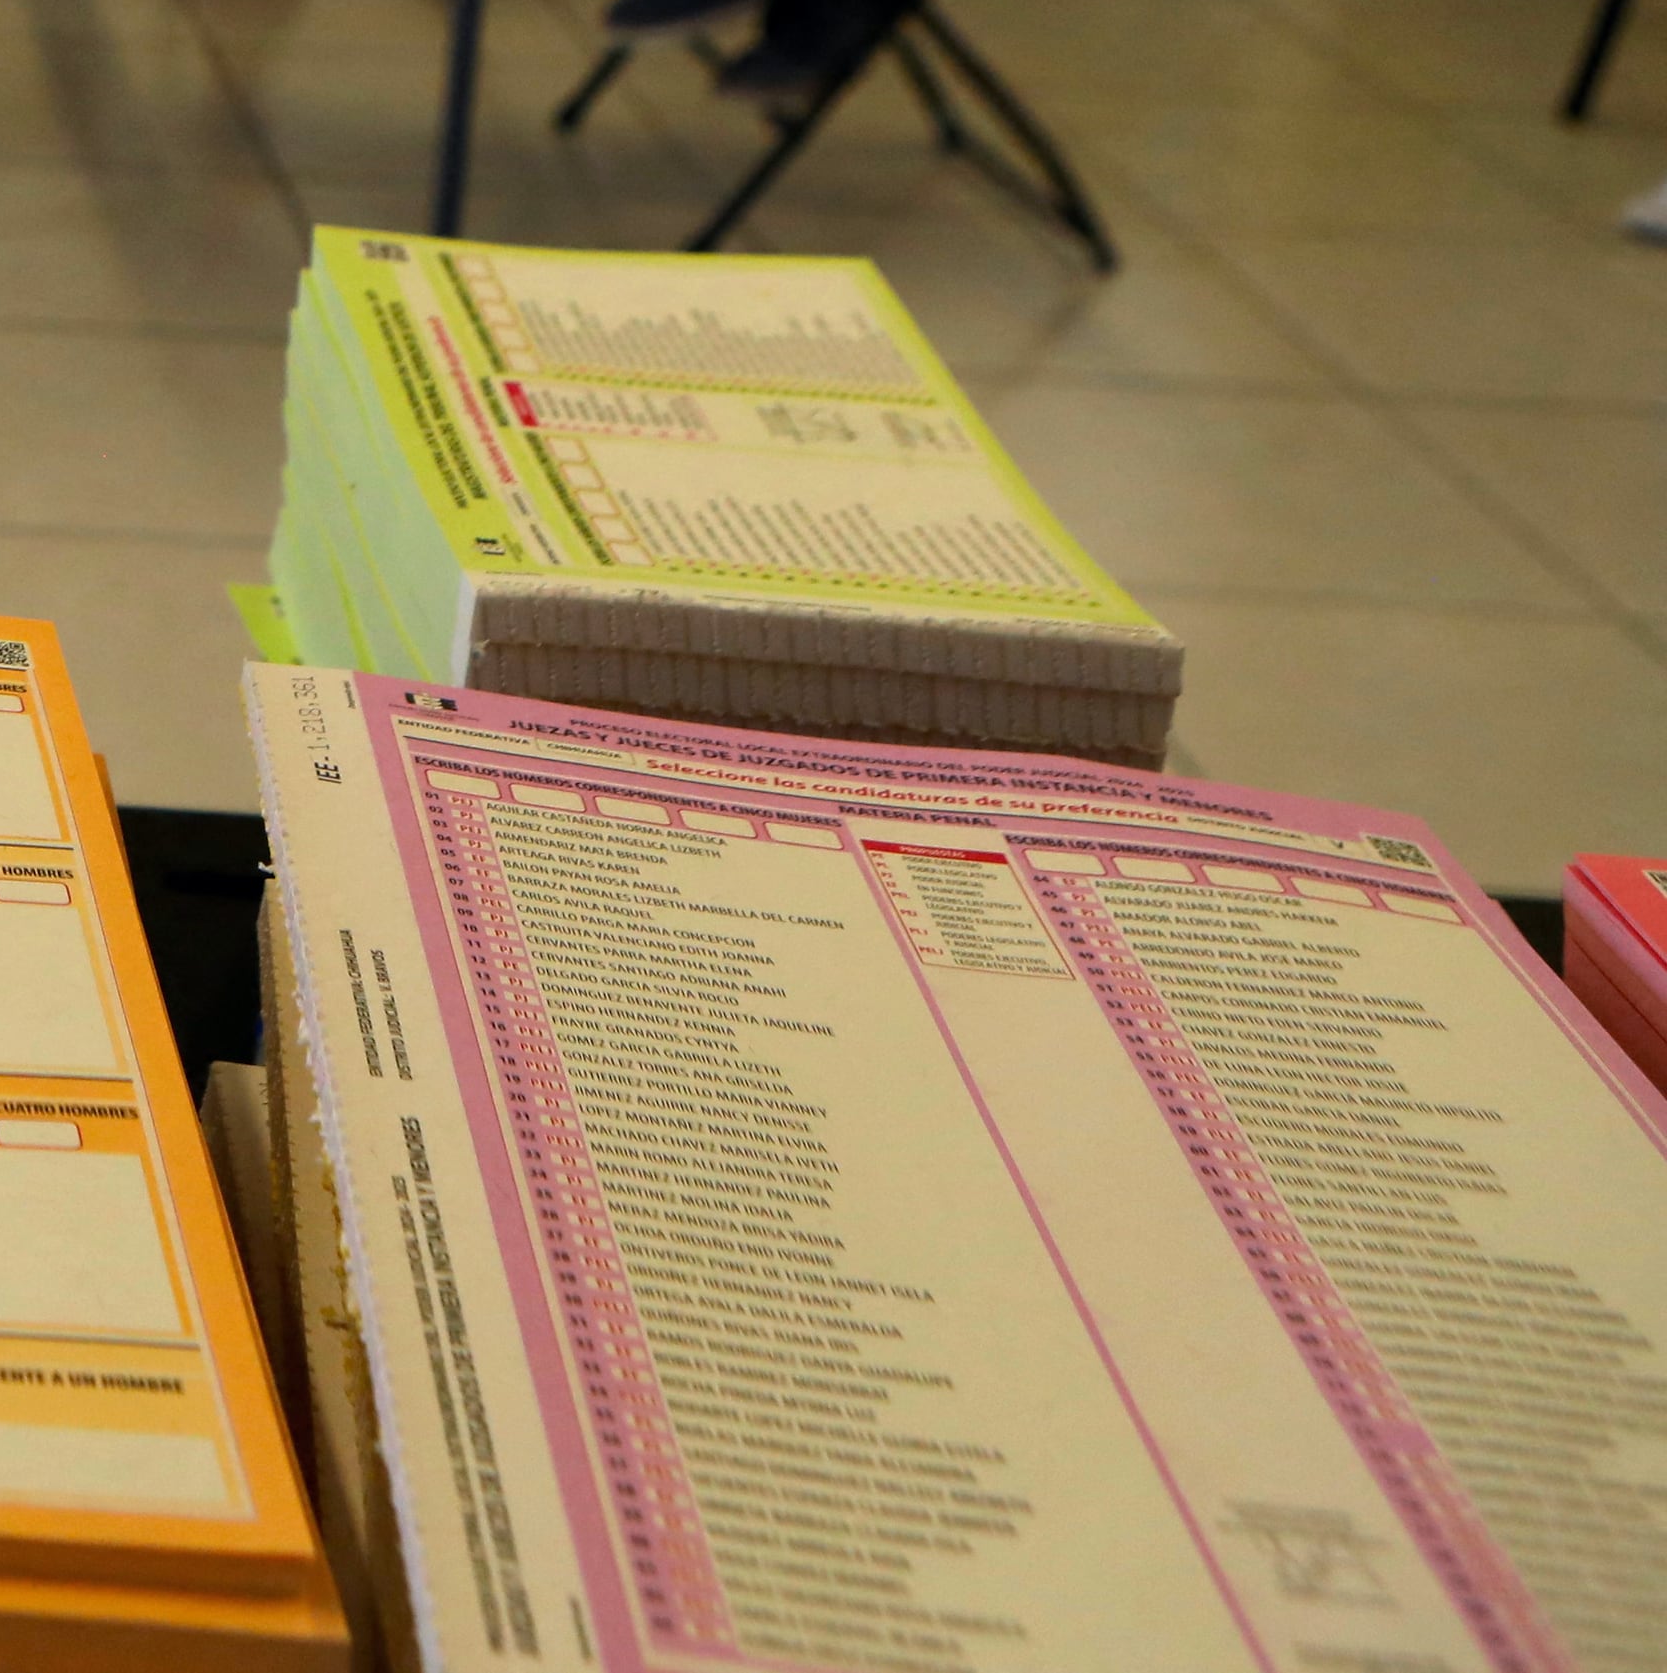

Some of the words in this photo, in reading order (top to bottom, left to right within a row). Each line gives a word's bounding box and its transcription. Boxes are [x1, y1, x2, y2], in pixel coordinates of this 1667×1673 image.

[510, 718, 590, 742] JUEZAS
[597, 733, 607, 745] Y
[617, 736, 695, 758] JUECES
[701, 748, 730, 763] DE
[739, 752, 859, 776] JUZGADOS
[865, 765, 894, 779] DE
[901, 768, 1003, 788] PRIMERA
[1011, 776, 1134, 802] INSTANCIA
[1142, 792, 1152, 804] Y
[1160, 794, 1273, 821] MENORES
[647, 758, 766, 786] Seleccione
[773, 775, 805, 793] las
[813, 782, 967, 806] candidaturas
[974, 793, 1001, 809] de
[1011, 800, 1034, 812] su
[1042, 800, 1178, 824] preferencia
[840, 804, 925, 822] MATERIA
[930, 812, 997, 826] PENAL
